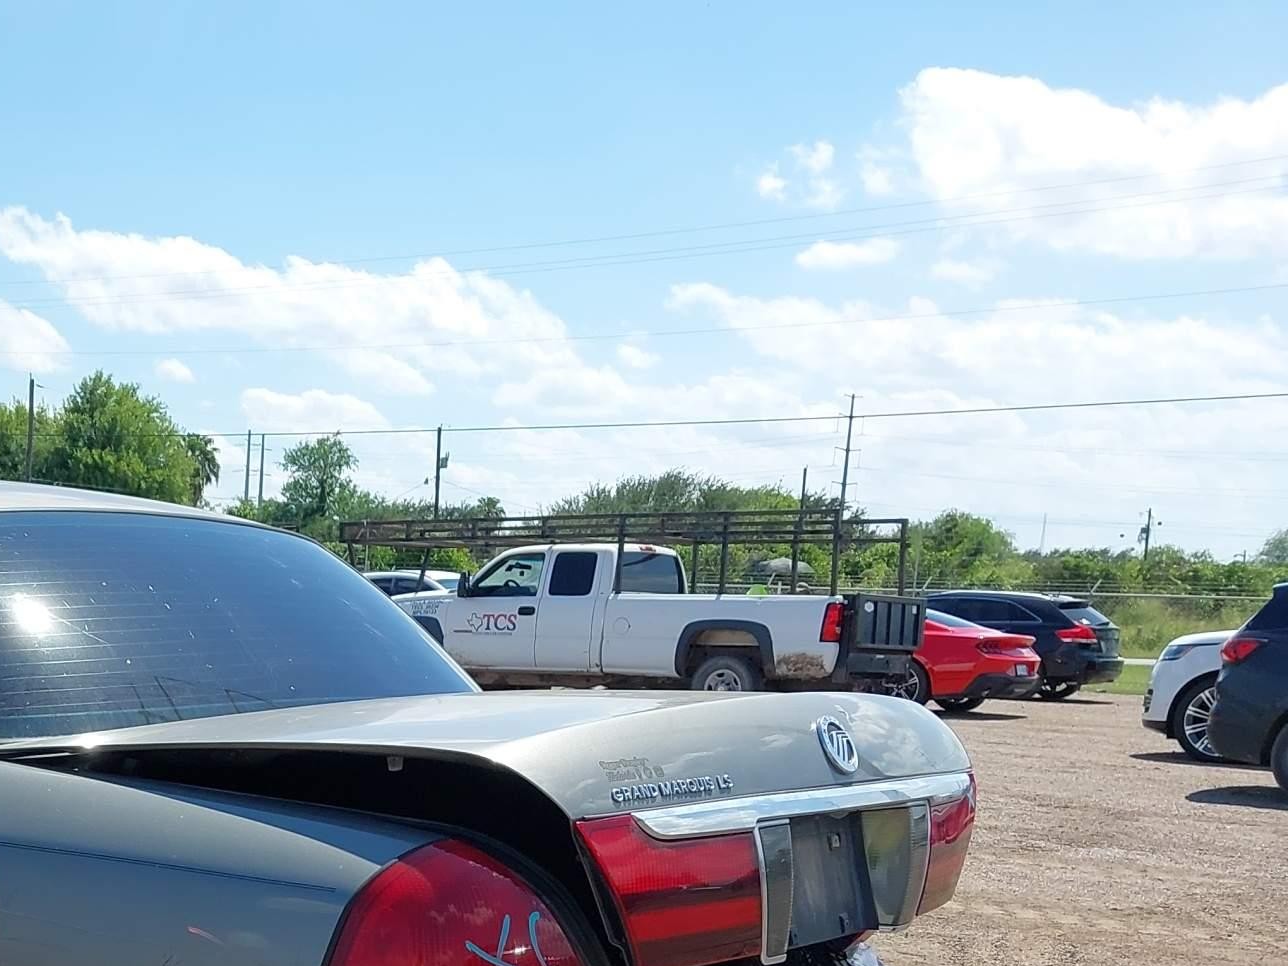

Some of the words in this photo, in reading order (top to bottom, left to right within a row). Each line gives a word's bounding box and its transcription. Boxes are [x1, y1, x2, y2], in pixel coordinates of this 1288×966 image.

[482, 613, 518, 631] TCS
[611, 782, 659, 802] GRAND
[659, 776, 715, 796] MARQUIS
[716, 774, 734, 790] LS
